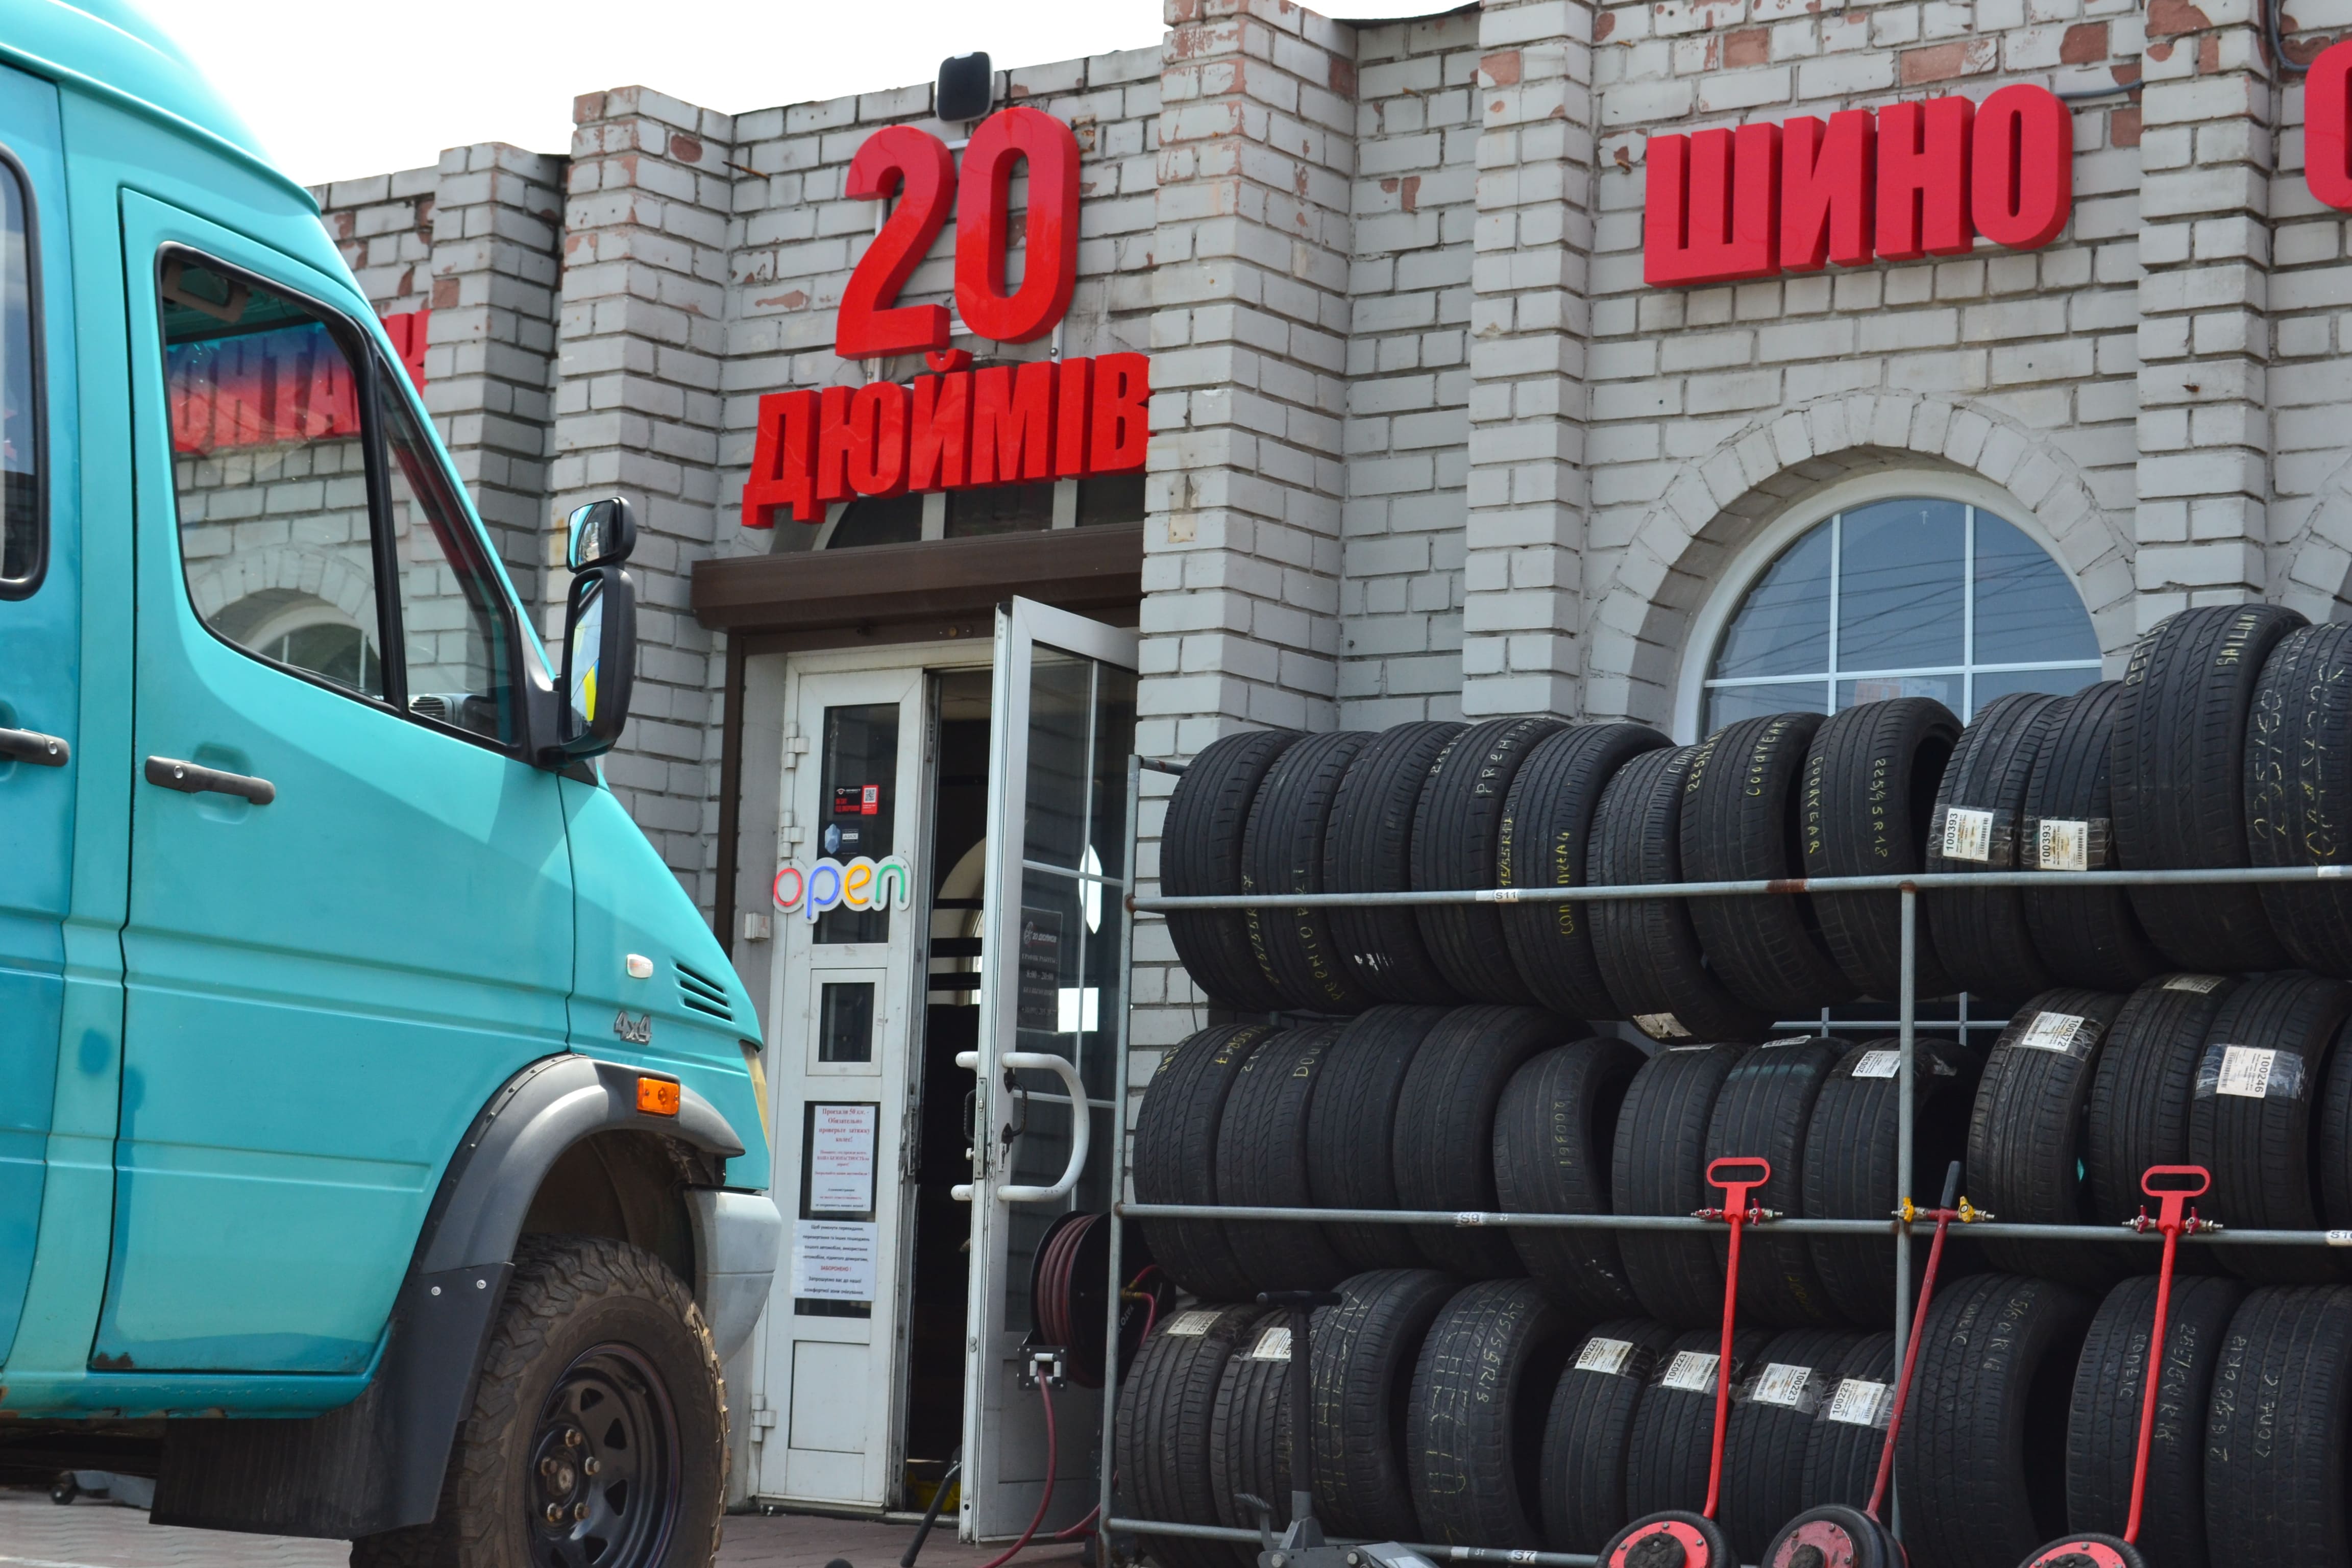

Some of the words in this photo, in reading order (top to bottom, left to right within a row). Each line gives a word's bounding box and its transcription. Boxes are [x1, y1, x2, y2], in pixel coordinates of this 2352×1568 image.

[1644, 83, 2073, 289] ШИНО
[836, 106, 1081, 360] 20
[741, 349, 1156, 529] ДЮЙМІВ
[1946, 813, 1958, 852] 100393
[2042, 824, 2051, 864] 100393
[773, 863, 905, 919] open
[1495, 891, 1516, 900] S11
[614, 1010, 652, 1045] 4x4
[2058, 1019, 2079, 1047] 100372
[2254, 1055, 2272, 1093] 100246
[1460, 1213, 1480, 1224] S9
[2330, 1231, 2352, 1239] S1
[1579, 1338, 1600, 1365] 100223
[1666, 1353, 1687, 1381] 100223
[1787, 1370, 1807, 1402] 100223
[1831, 1382, 1851, 1415] 100223
[1513, 1551, 1537, 1562] S7
